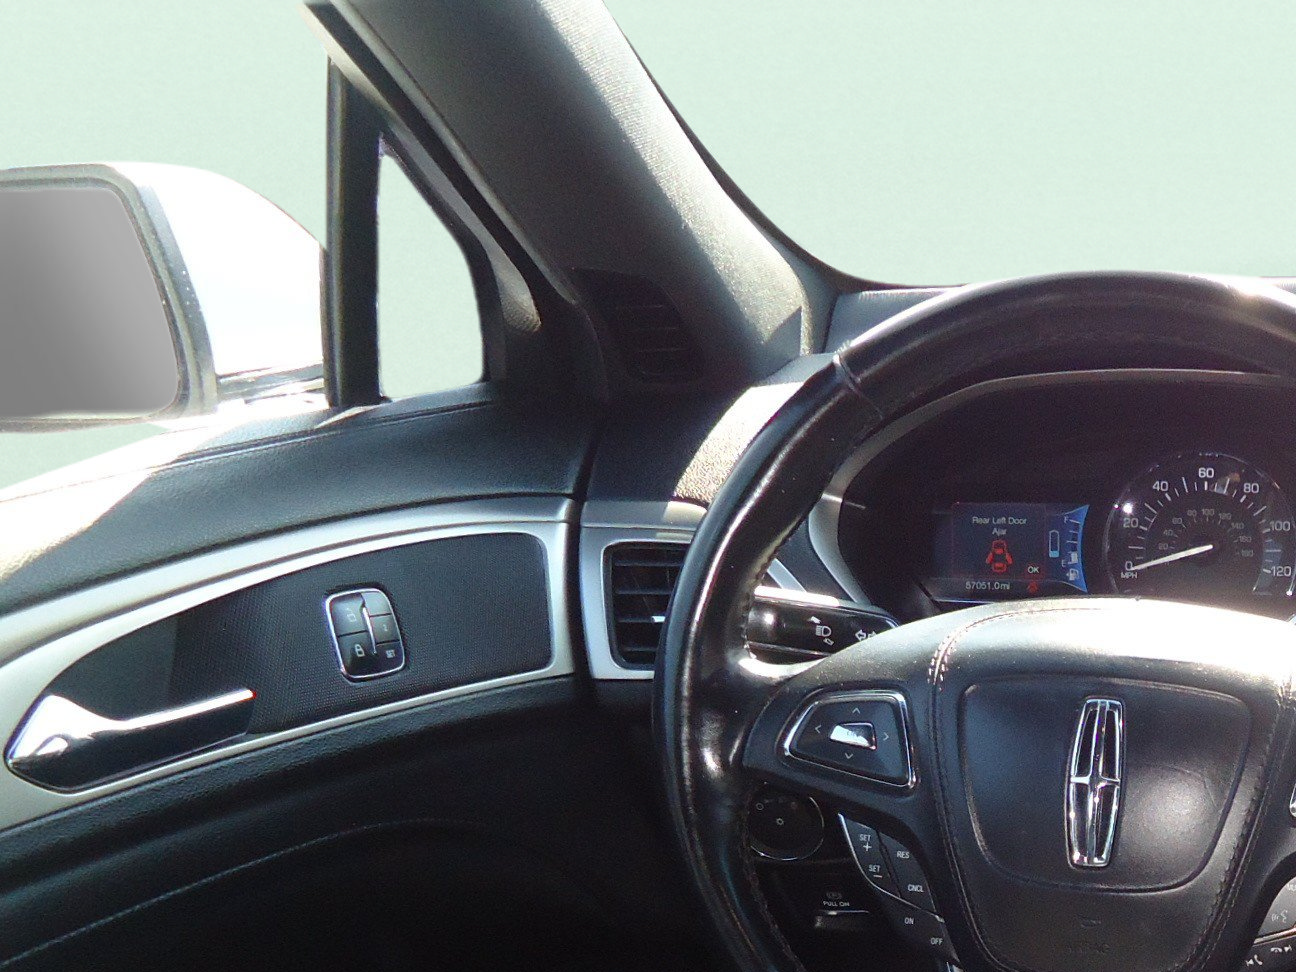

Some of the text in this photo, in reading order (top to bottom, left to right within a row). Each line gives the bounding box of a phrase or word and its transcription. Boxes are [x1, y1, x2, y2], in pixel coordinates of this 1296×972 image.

[1198, 467, 1214, 479] 60
[1152, 480, 1169, 491] 40
[1243, 482, 1260, 494] 80
[972, 516, 1028, 525] Rear Left Door
[1123, 517, 1139, 528] 20
[1269, 520, 1291, 532] 100
[992, 527, 1007, 537] Ajar
[1027, 566, 1040, 574] OK
[1271, 566, 1292, 577] 120
[1121, 571, 1138, 579] MPH
[859, 834, 871, 842] SET
[896, 850, 910, 859] RES
[868, 864, 881, 873] SET
[907, 884, 924, 893] CNCL
[904, 917, 914, 925] ON
[930, 937, 943, 946] OFF
